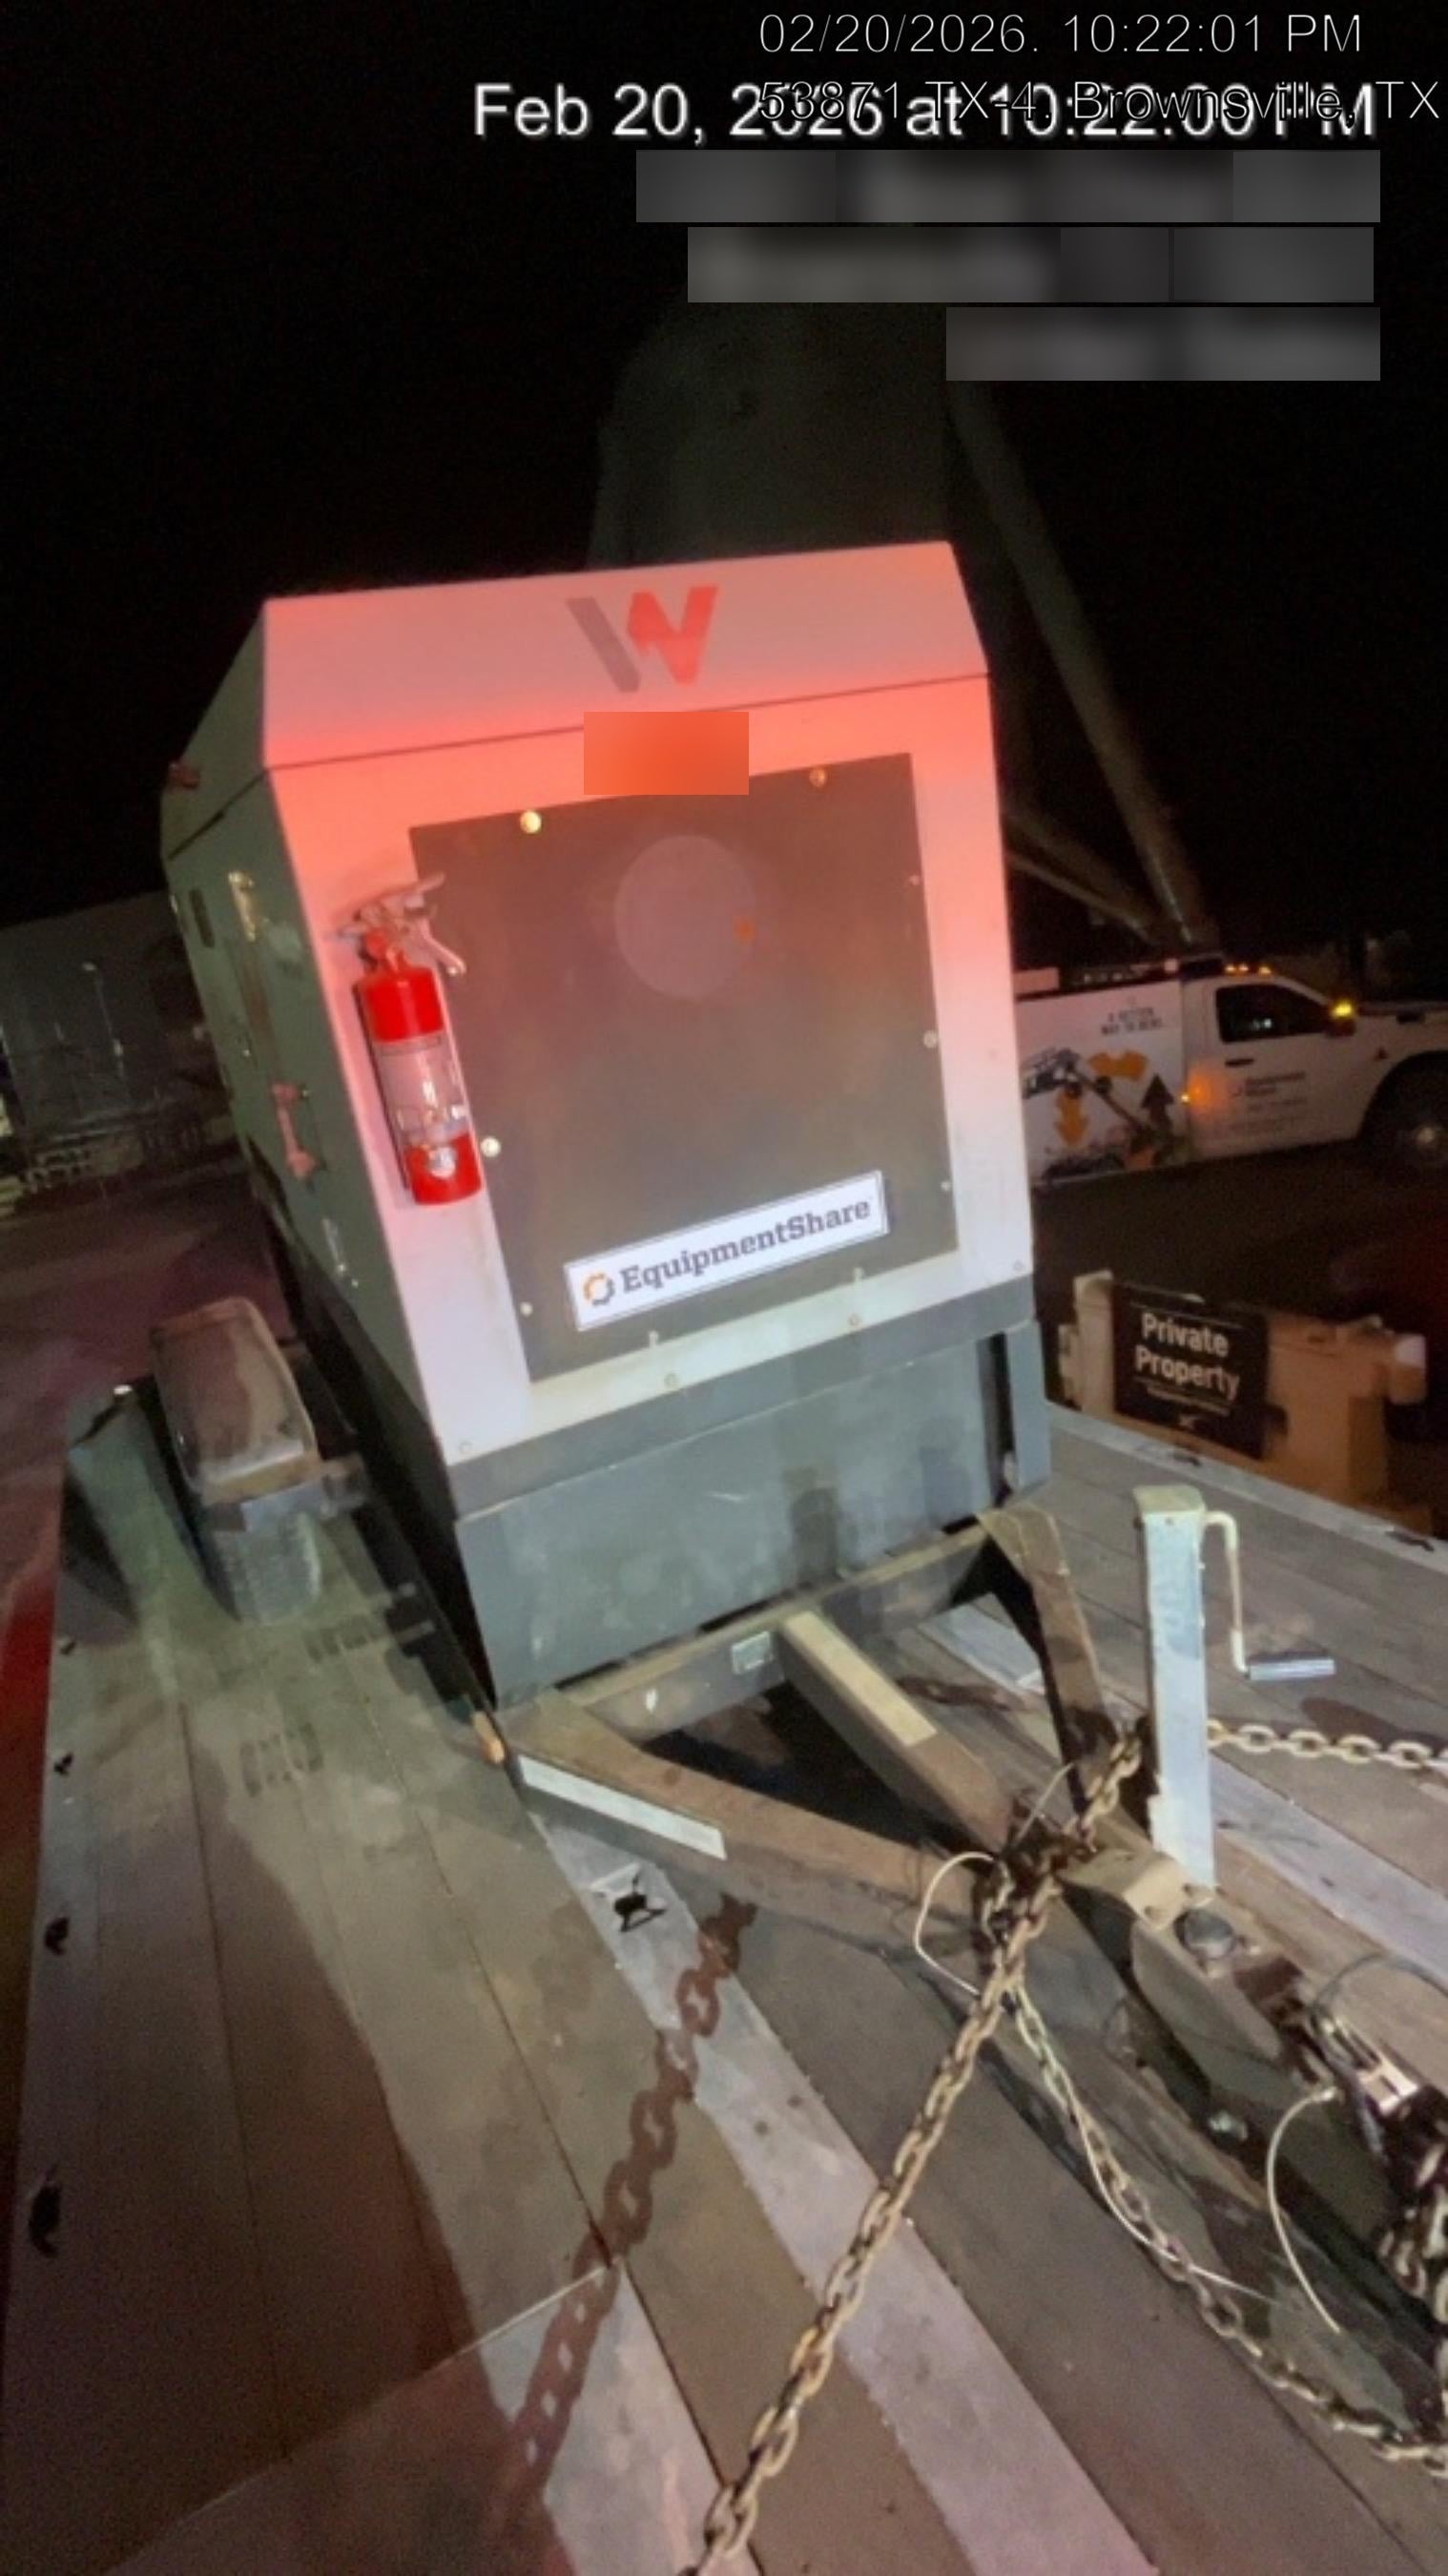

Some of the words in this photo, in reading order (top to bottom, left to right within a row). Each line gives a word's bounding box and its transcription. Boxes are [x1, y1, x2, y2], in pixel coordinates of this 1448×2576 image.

[619, 1200, 872, 1295] EquipmentShare
[1142, 1312, 1230, 1358] Private
[1135, 1344, 1240, 1402] Property
